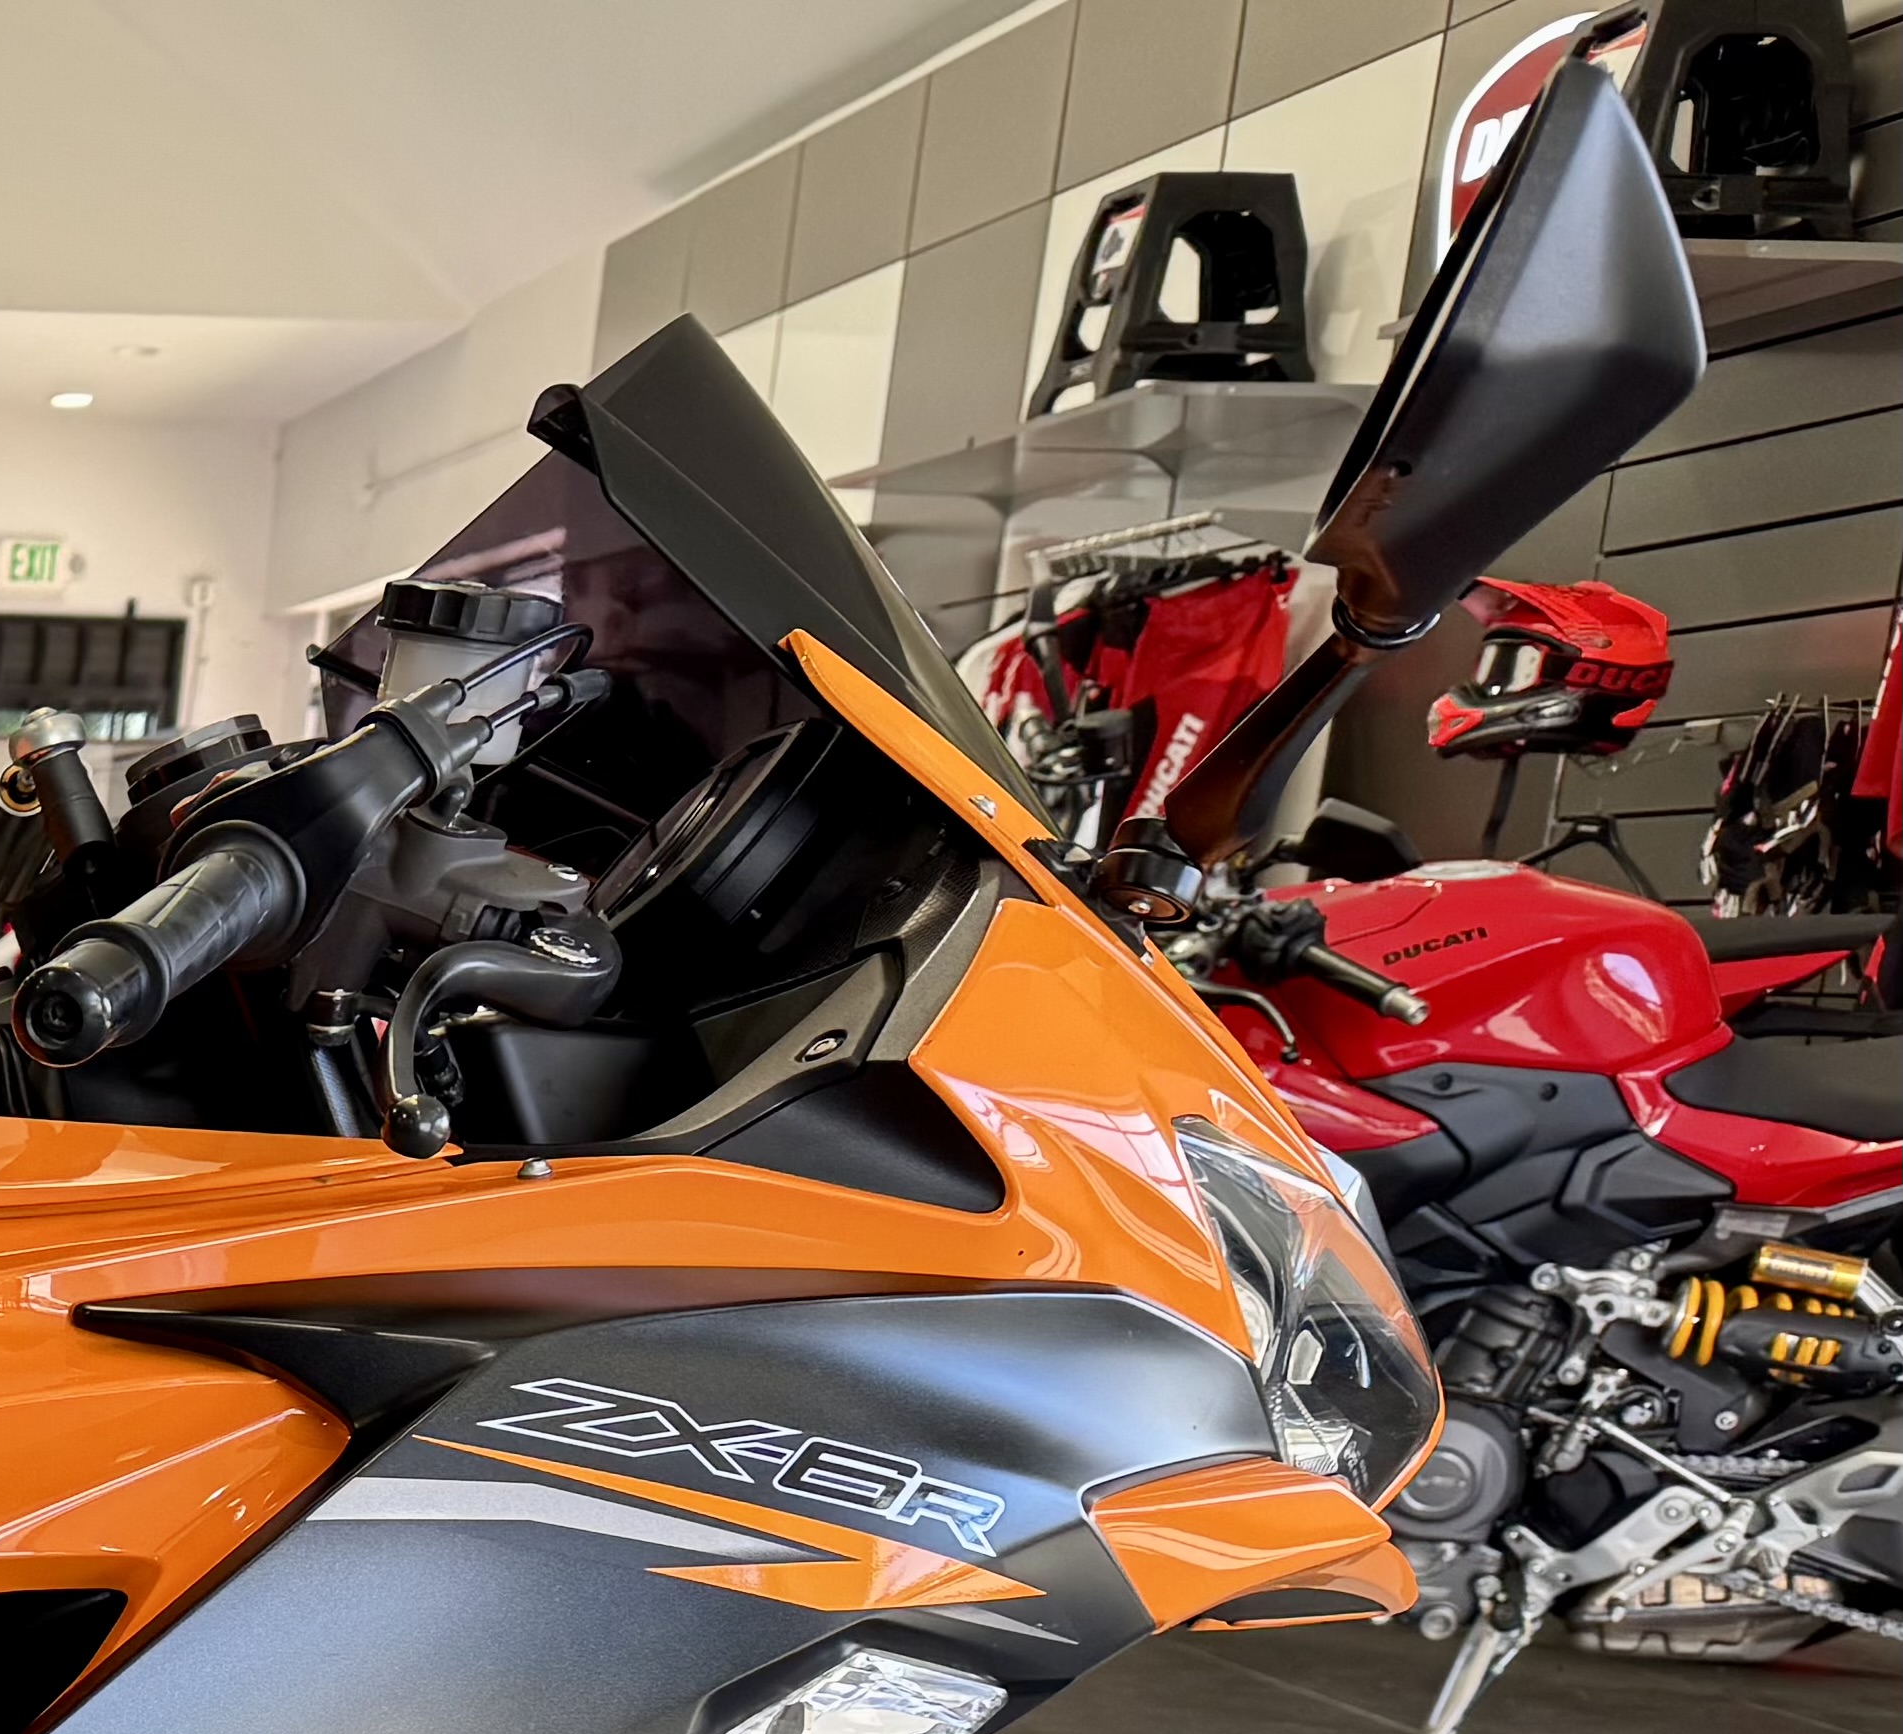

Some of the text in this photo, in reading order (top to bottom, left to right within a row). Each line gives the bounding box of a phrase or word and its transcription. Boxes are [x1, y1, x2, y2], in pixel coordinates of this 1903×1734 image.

[9, 543, 61, 583] EXIT
[1382, 926, 1489, 967] DUCATI
[476, 1377, 1007, 1558] ZX-6R
